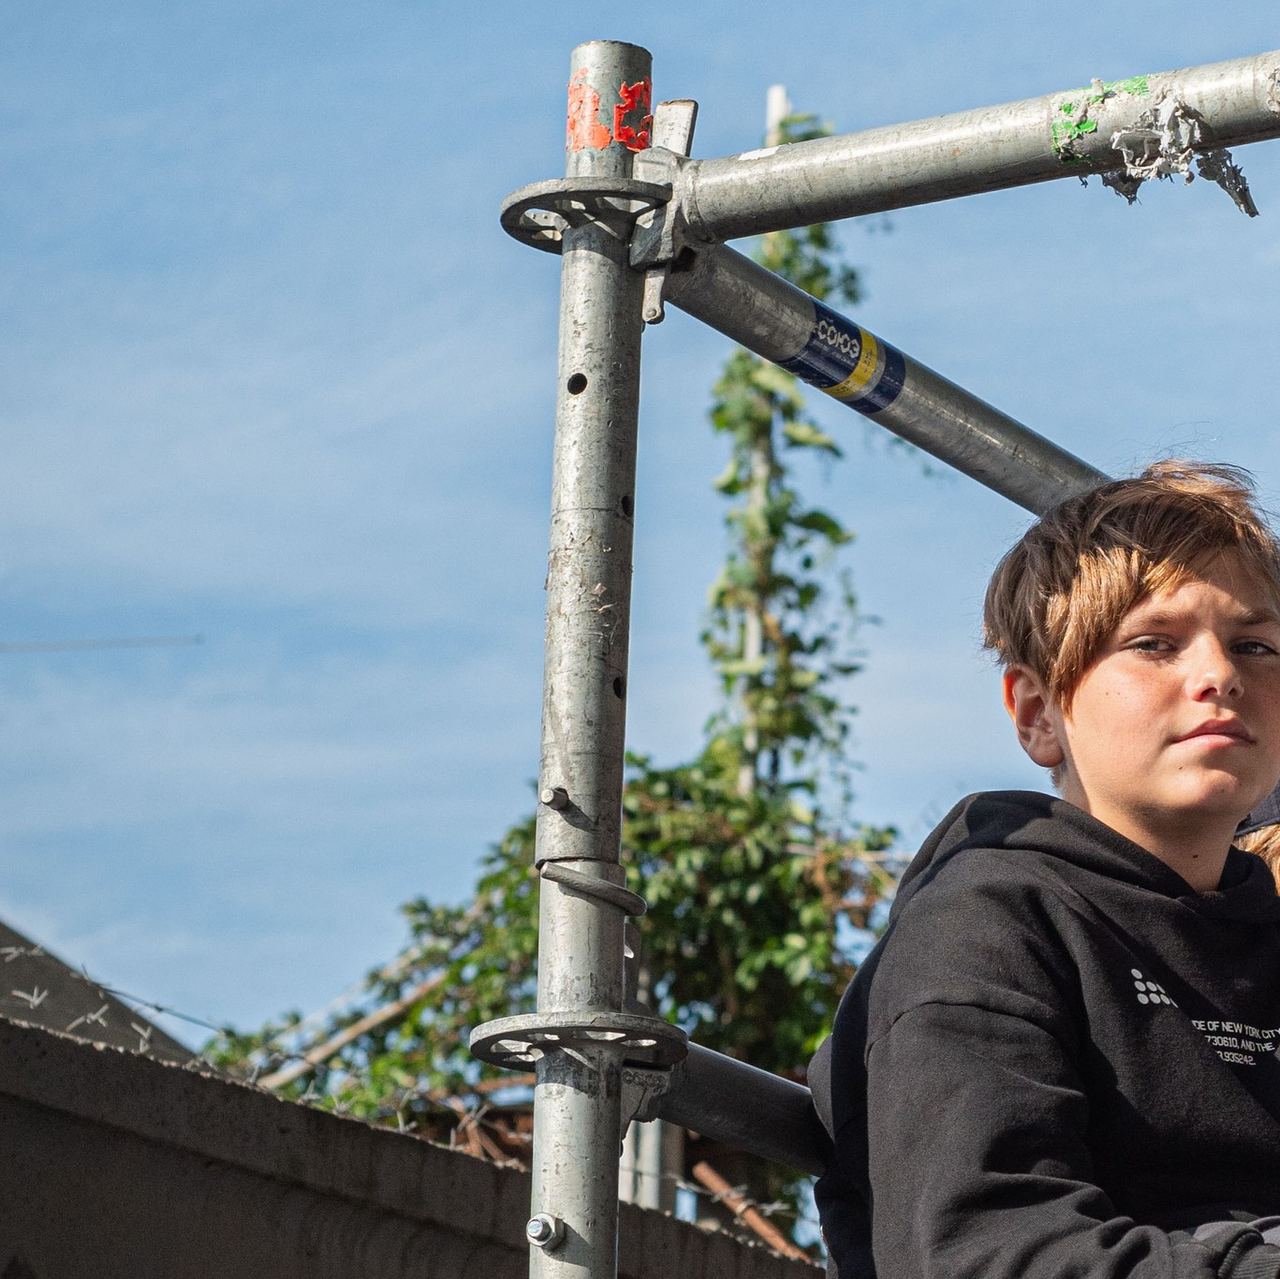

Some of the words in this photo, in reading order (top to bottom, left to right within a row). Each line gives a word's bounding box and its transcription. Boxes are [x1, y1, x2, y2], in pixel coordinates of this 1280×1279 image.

[1207, 1020, 1220, 1031] OF
[1221, 1021, 1243, 1034] NEW
[1243, 1024, 1262, 1039] YORK
[1240, 1038, 1256, 1052] AND
[1255, 1041, 1276, 1052] THE
